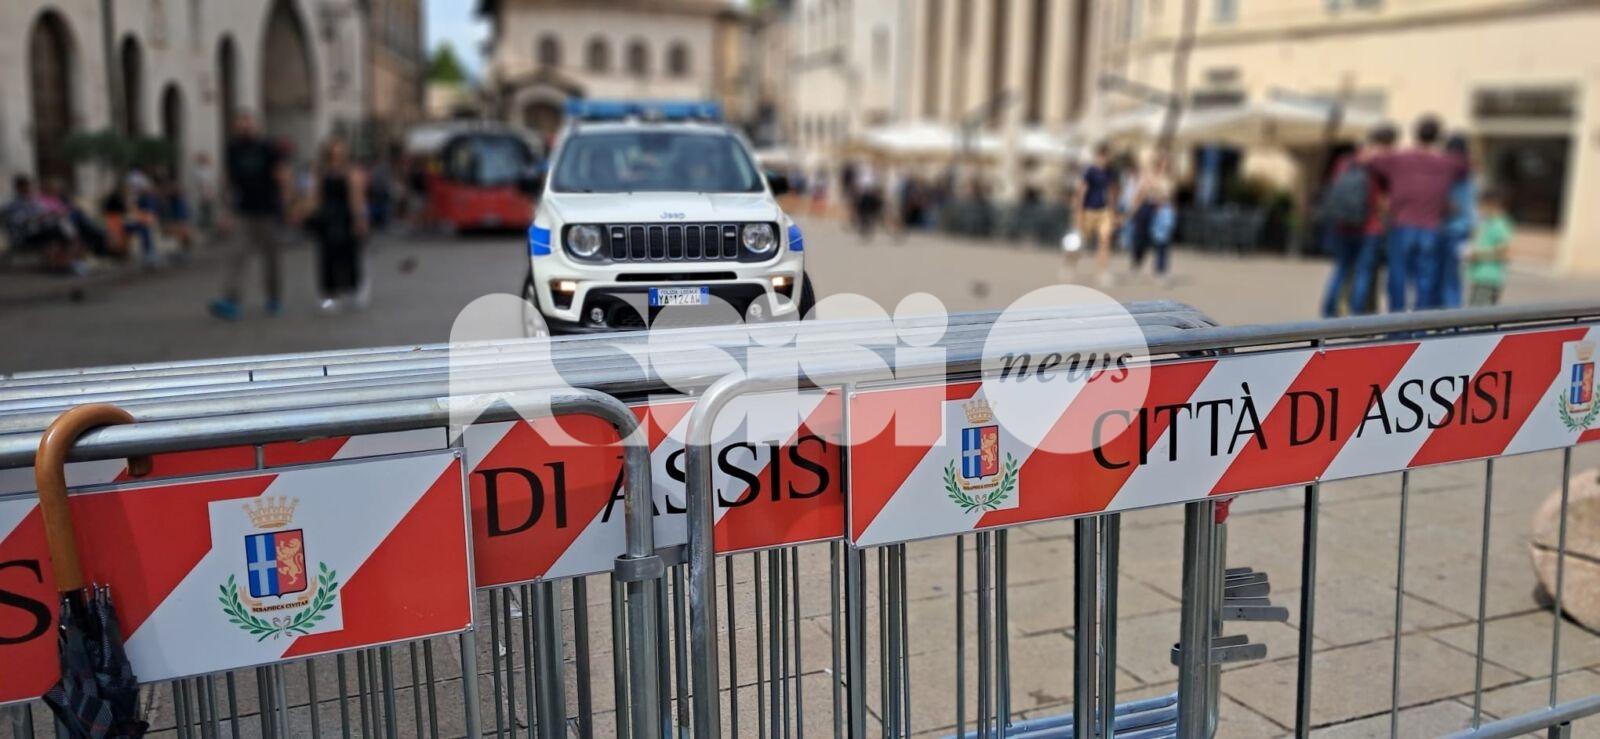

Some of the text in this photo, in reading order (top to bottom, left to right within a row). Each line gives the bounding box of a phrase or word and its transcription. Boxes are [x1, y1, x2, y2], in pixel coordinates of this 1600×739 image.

[659, 211, 687, 220] Jeep
[1092, 370, 1513, 470] CITTÀ DI ASSISI
[474, 461, 568, 538] DI
